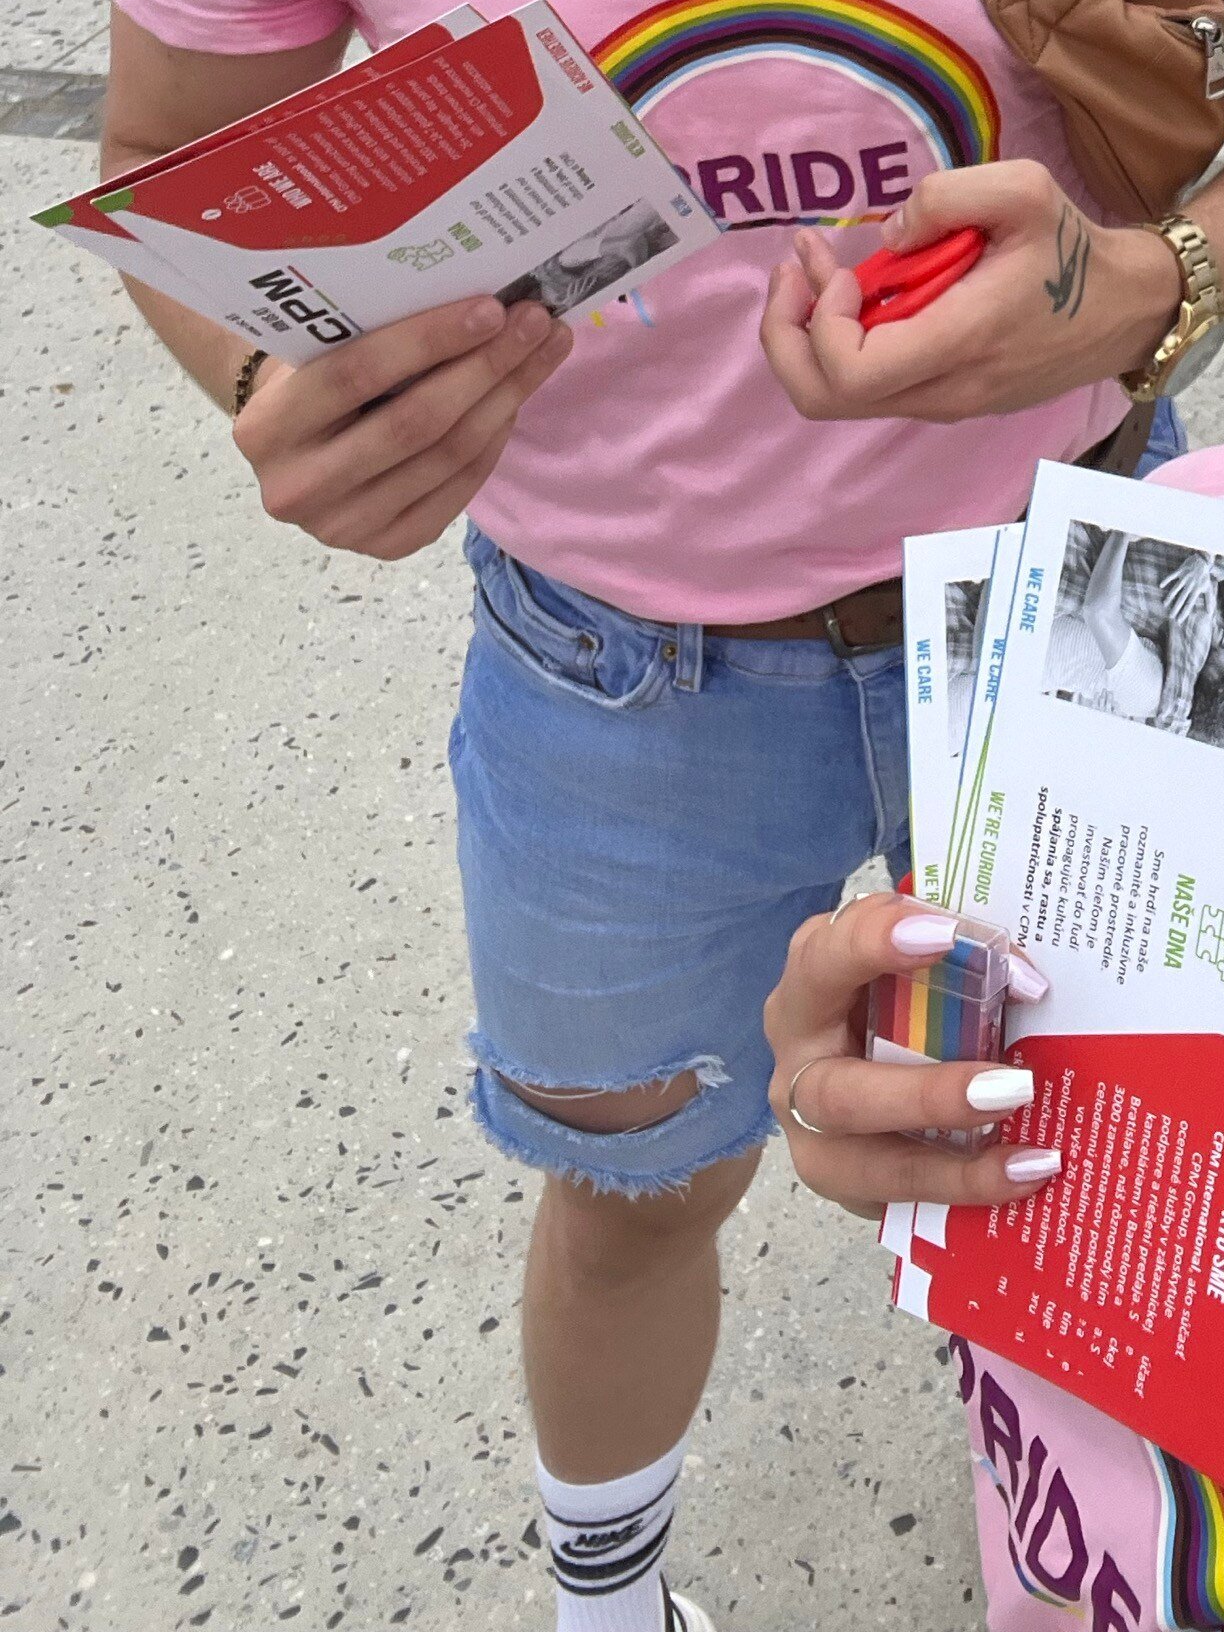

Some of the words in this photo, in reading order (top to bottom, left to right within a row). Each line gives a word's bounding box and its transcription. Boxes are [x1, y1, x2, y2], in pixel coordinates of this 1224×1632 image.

[252, 161, 283, 181] ARE
[268, 175, 295, 193] WE
[673, 141, 912, 218] RIDE
[281, 187, 312, 209] WHO
[249, 269, 352, 344] CPM
[1026, 567, 1044, 591] WE
[1019, 592, 1039, 633] CARE
[916, 638, 931, 661] WE
[917, 665, 932, 704] CARE
[983, 791, 1005, 839] WE'RE
[1023, 787, 1048, 901] spolupatričnosti
[1046, 808, 1062, 867] spájania
[1059, 813, 1079, 893] propagujúc
[1112, 824, 1131, 891] pracovné
[973, 840, 997, 905] CURIOUS
[1040, 869, 1053, 889] sa,
[1129, 825, 1149, 898] rozmanité
[1150, 849, 1165, 881] Sme
[922, 863, 940, 903] WE'R
[1145, 884, 1160, 915] hrdí
[1170, 873, 1195, 927] NAŠE
[1021, 903, 1030, 913] v
[1036, 893, 1049, 930] rastu
[1051, 896, 1069, 947] kultúru
[1089, 883, 1104, 932] cieľom
[1127, 899, 1137, 910] a
[1014, 914, 1030, 948] CPM
[1034, 932, 1043, 942] a
[1085, 932, 1098, 949] je
[1100, 893, 1119, 970] prostredie.
[1141, 916, 1152, 935] na
[1116, 913, 1136, 985] inkluzívne
[1135, 938, 1149, 973] naše
[1163, 928, 1187, 969] DNA
[1074, 1105, 1085, 1124] vo
[1086, 1081, 1106, 1158] celodennú
[1110, 1084, 1126, 1123] 3000
[1069, 1127, 1082, 1159] vyše
[1118, 1095, 1141, 1169] Bratislave,
[1153, 1114, 1171, 1179] podpore
[1170, 1120, 1188, 1184] ocenené
[1209, 1131, 1224, 1168] CPM
[1065, 1160, 1079, 1181] 26
[1093, 1124, 1117, 1227] zamestnancov
[1131, 1112, 1156, 1206] kanceláriami
[1187, 1151, 1203, 1188] CPM
[1044, 1186, 1055, 1203] so
[1076, 1158, 1094, 1222] globálnu
[1114, 1174, 1126, 1201] náš
[1150, 1180, 1161, 1191] a
[1054, 1181, 1074, 1246] jazykoch.
[1129, 1208, 1138, 1218] v
[1142, 1193, 1158, 1245] riešení
[1160, 1186, 1178, 1234] služby
[1176, 1190, 1196, 1239] Group,
[1189, 1170, 1217, 1272] International,
[1034, 1205, 1051, 1271] známymi
[1065, 1224, 1083, 1287] podporu
[1116, 1220, 1138, 1294] Barcelone
[1159, 1236, 1168, 1246] v
[1080, 1229, 1099, 1301] poskytuje
[1131, 1245, 1149, 1305] predaja.
[1164, 1243, 1184, 1318] poskytuje
[1096, 1280, 1109, 1306] tím
[1113, 1295, 1123, 1306] a
[1142, 1248, 1166, 1333] zákazníckej
[1184, 1277, 1197, 1307] ako
[1128, 1309, 1140, 1322] S
[1174, 1308, 1191, 1360] súčasť
